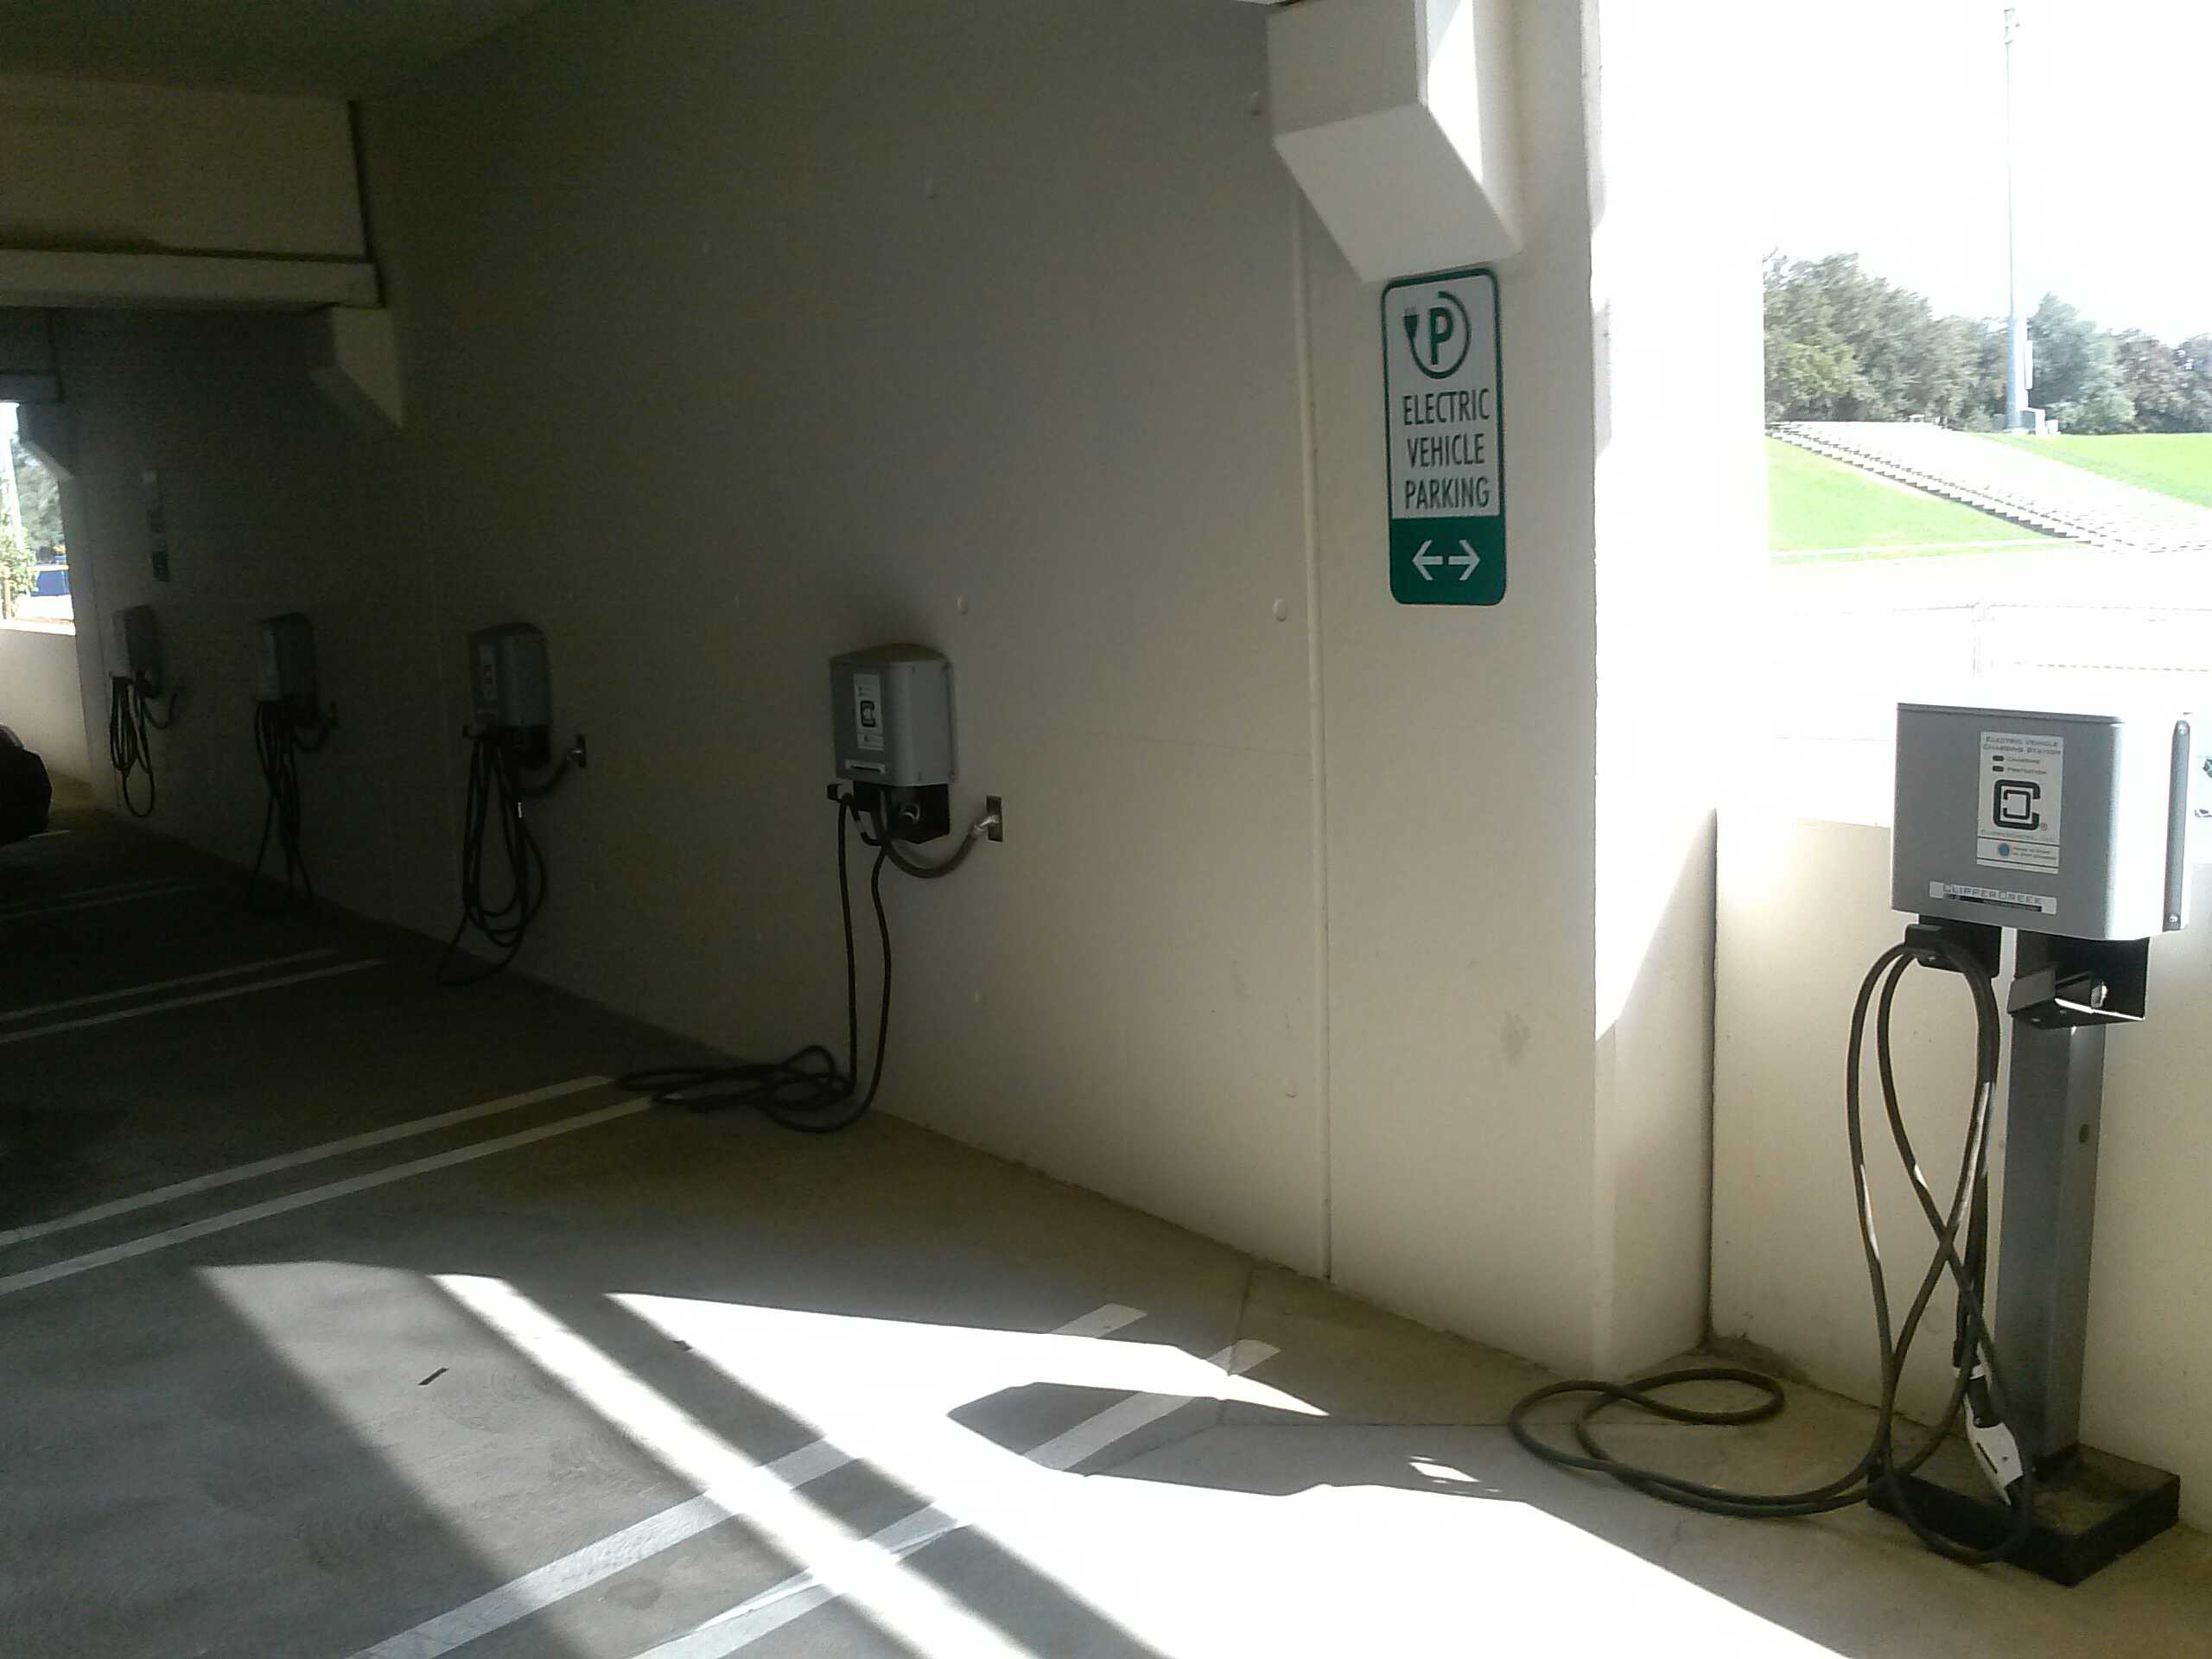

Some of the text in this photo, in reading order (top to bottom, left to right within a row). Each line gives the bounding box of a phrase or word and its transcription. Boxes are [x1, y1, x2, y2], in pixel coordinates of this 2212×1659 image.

[1430, 306, 1454, 365] P
[1402, 387, 1491, 426] ELECTRIC
[1407, 433, 1485, 469] VEHICLE
[1405, 476, 1491, 511] PARKING
